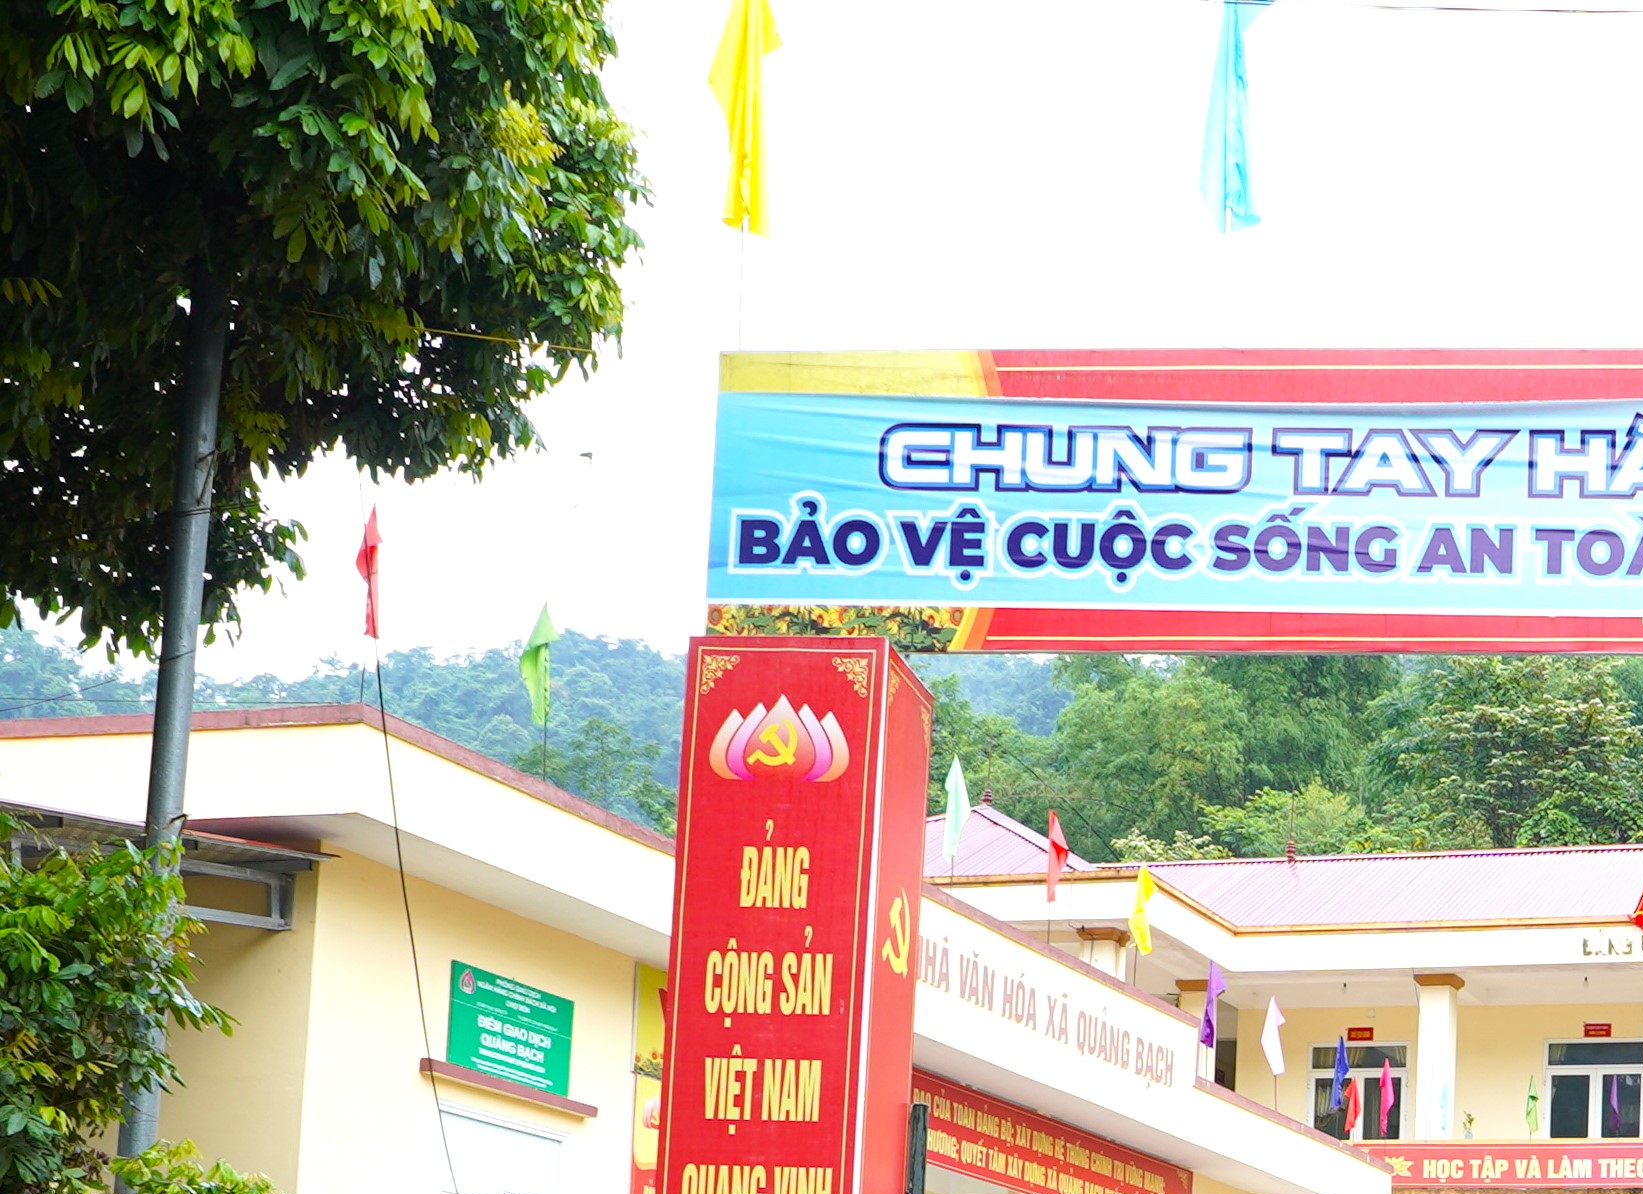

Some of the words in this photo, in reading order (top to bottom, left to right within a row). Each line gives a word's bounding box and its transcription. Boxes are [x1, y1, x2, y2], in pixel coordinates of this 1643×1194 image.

[879, 422, 1253, 493] CHUNG
[1272, 428, 1517, 497] TAY
[738, 499, 884, 567] BẢO
[902, 507, 984, 583] VỆ
[1006, 507, 1192, 583] CUỘC
[1215, 505, 1397, 574] SỐNG
[1413, 526, 1514, 575] AN
[739, 819, 810, 909] ĐẢNG
[704, 938, 774, 1028] CỘNG
[779, 925, 833, 1016] SẢN
[959, 951, 995, 1011] VĂN
[1001, 973, 1037, 1031] HÓA
[1045, 993, 1068, 1044] XÃ
[1077, 1006, 1130, 1069] QUẢNG
[1135, 1036, 1174, 1088] BẠCH
[704, 1044, 758, 1135] VIỆT
[761, 1058, 822, 1122] NAM
[1423, 1158, 1464, 1183] HỌC
[1470, 1152, 1508, 1183] TẬP
[1515, 1154, 1542, 1179] VÀ
[1548, 1154, 1592, 1179] LÀM
